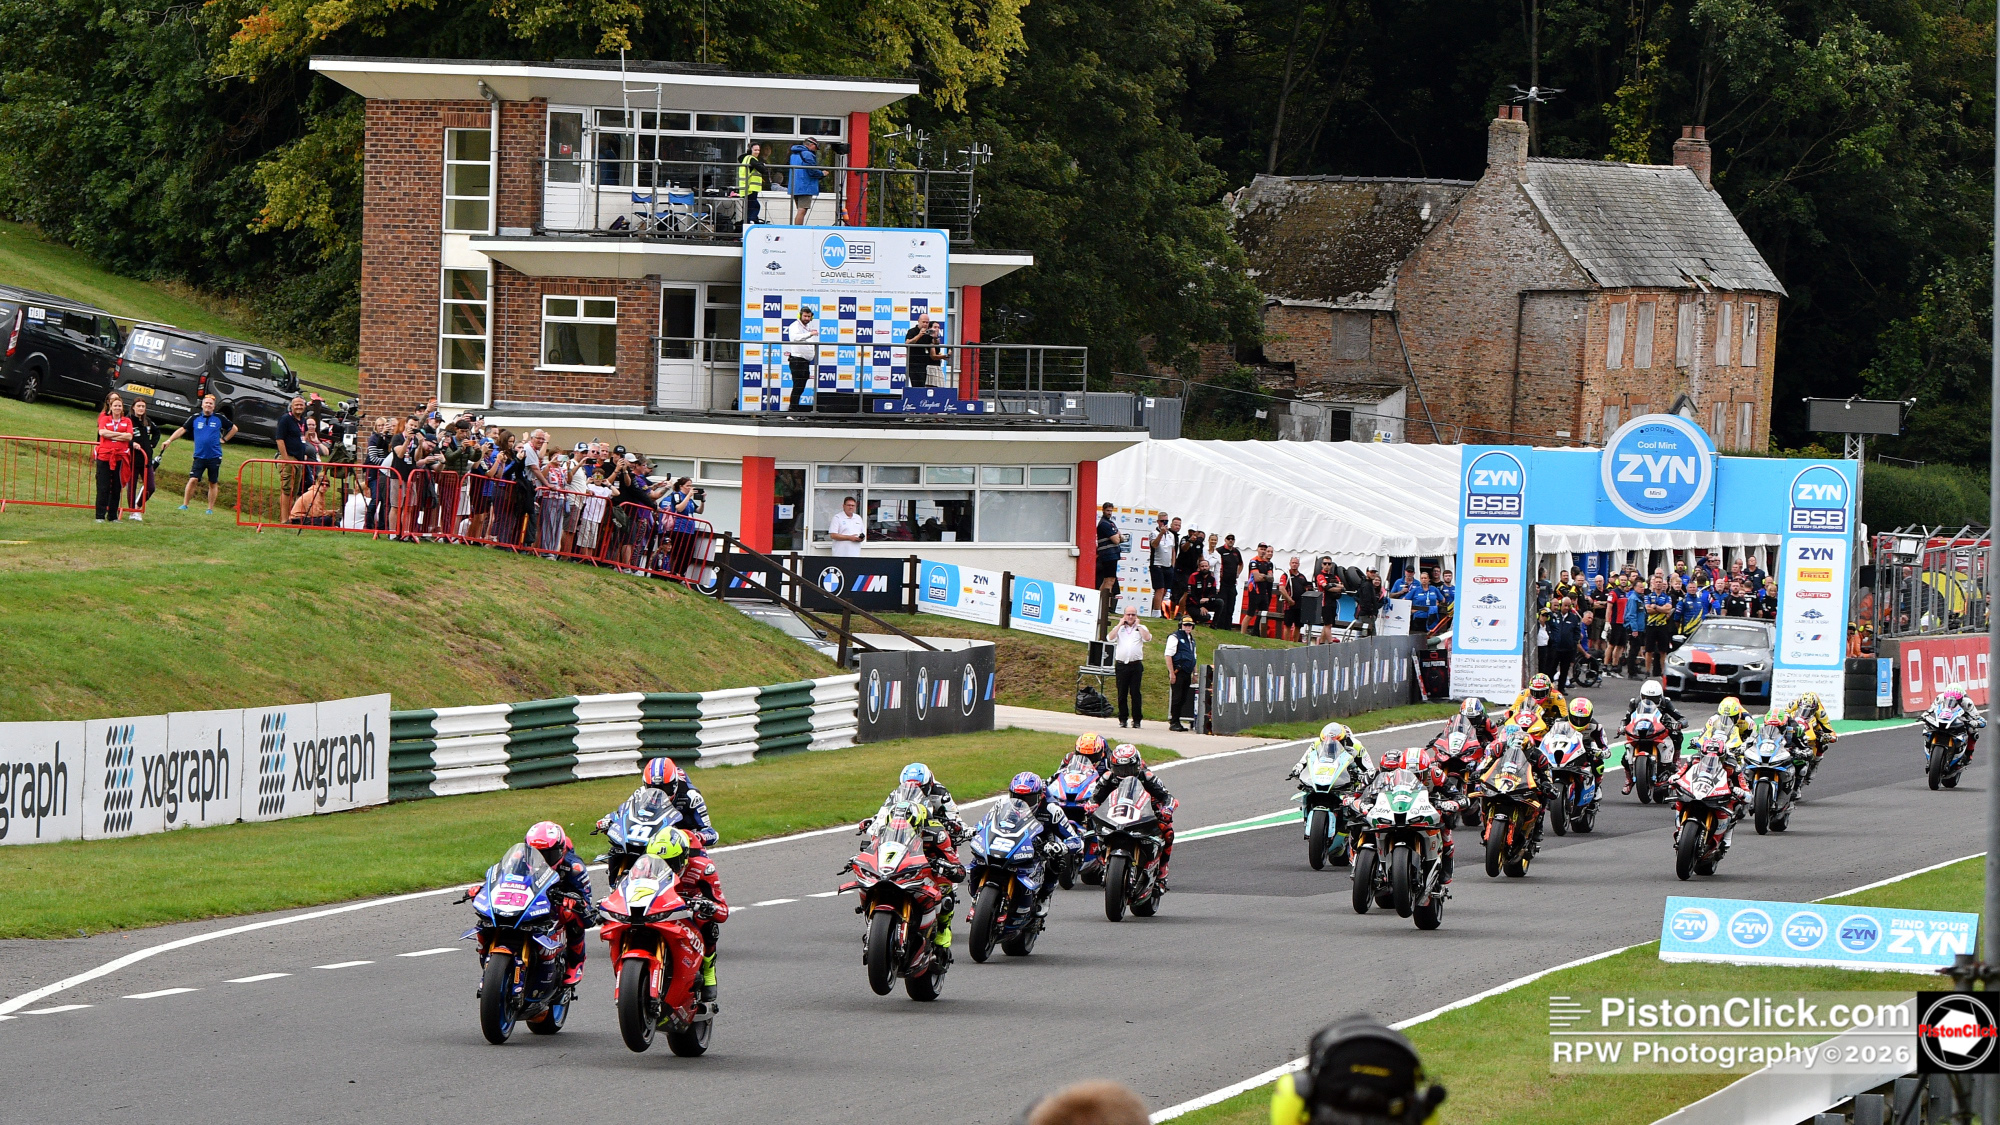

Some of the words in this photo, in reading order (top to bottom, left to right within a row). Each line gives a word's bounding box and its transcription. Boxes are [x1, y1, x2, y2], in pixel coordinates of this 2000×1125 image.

[824, 246, 844, 257] ZYN
[849, 244, 871, 255] BSB
[764, 303, 780, 311] ZYN
[840, 304, 855, 312] ZYN
[875, 305, 890, 313] ZYN
[911, 306, 927, 314] ZYN
[745, 326, 761, 334] ZYN
[821, 327, 837, 335] ZYN
[857, 328, 872, 336] ZYN
[893, 328, 908, 336] ZYN
[136, 336, 161, 348] TSL
[839, 350, 854, 358] ZYN
[874, 350, 890, 358] ZYN
[744, 372, 760, 380] ZYN
[820, 372, 836, 380] ZYN
[1638, 441, 1656, 449] Cool
[1658, 442, 1678, 450] Mint
[1617, 454, 1696, 485] ZYN
[1474, 470, 1518, 486] ZYN
[1798, 484, 1842, 500] ZYN
[1470, 496, 1520, 510] BSB
[1793, 510, 1844, 526] BSB
[1475, 533, 1510, 546] ZYN
[1798, 548, 1833, 560] ZYN
[1478, 556, 1506, 564] PIRELLI
[931, 574, 946, 585] ZYN
[973, 575, 988, 585] ZYN
[930, 587, 946, 598] BSB
[1025, 591, 1040, 601] ZYN
[1068, 592, 1086, 603] ZYN
[1023, 604, 1040, 614] BSB
[1933, 653, 1990, 692] OMOLO
[1517, 716, 1532, 726] 86
[292, 713, 374, 808] xograph
[140, 728, 229, 824] xograph
[1315, 766, 1336, 776] 21
[1696, 783, 1711, 794] 45
[1112, 804, 1134, 820] 91
[627, 824, 652, 841] 11
[990, 837, 1016, 852] 52
[656, 846, 667, 855] J1
[886, 852, 896, 864] 1
[500, 882, 526, 890] McAMS
[494, 892, 529, 907] 28
[628, 887, 656, 902] 7
[529, 908, 550, 917] YAMAHA
[1673, 918, 1707, 932] ZYN
[1733, 922, 1767, 936] ZYN
[1890, 918, 1925, 930] FIND
[1929, 920, 1969, 932] YOUR
[1788, 925, 1822, 938] ZYN
[1842, 928, 1876, 940] ZYN
[674, 920, 704, 956] HONDA
[1887, 928, 1968, 956] ZYN
